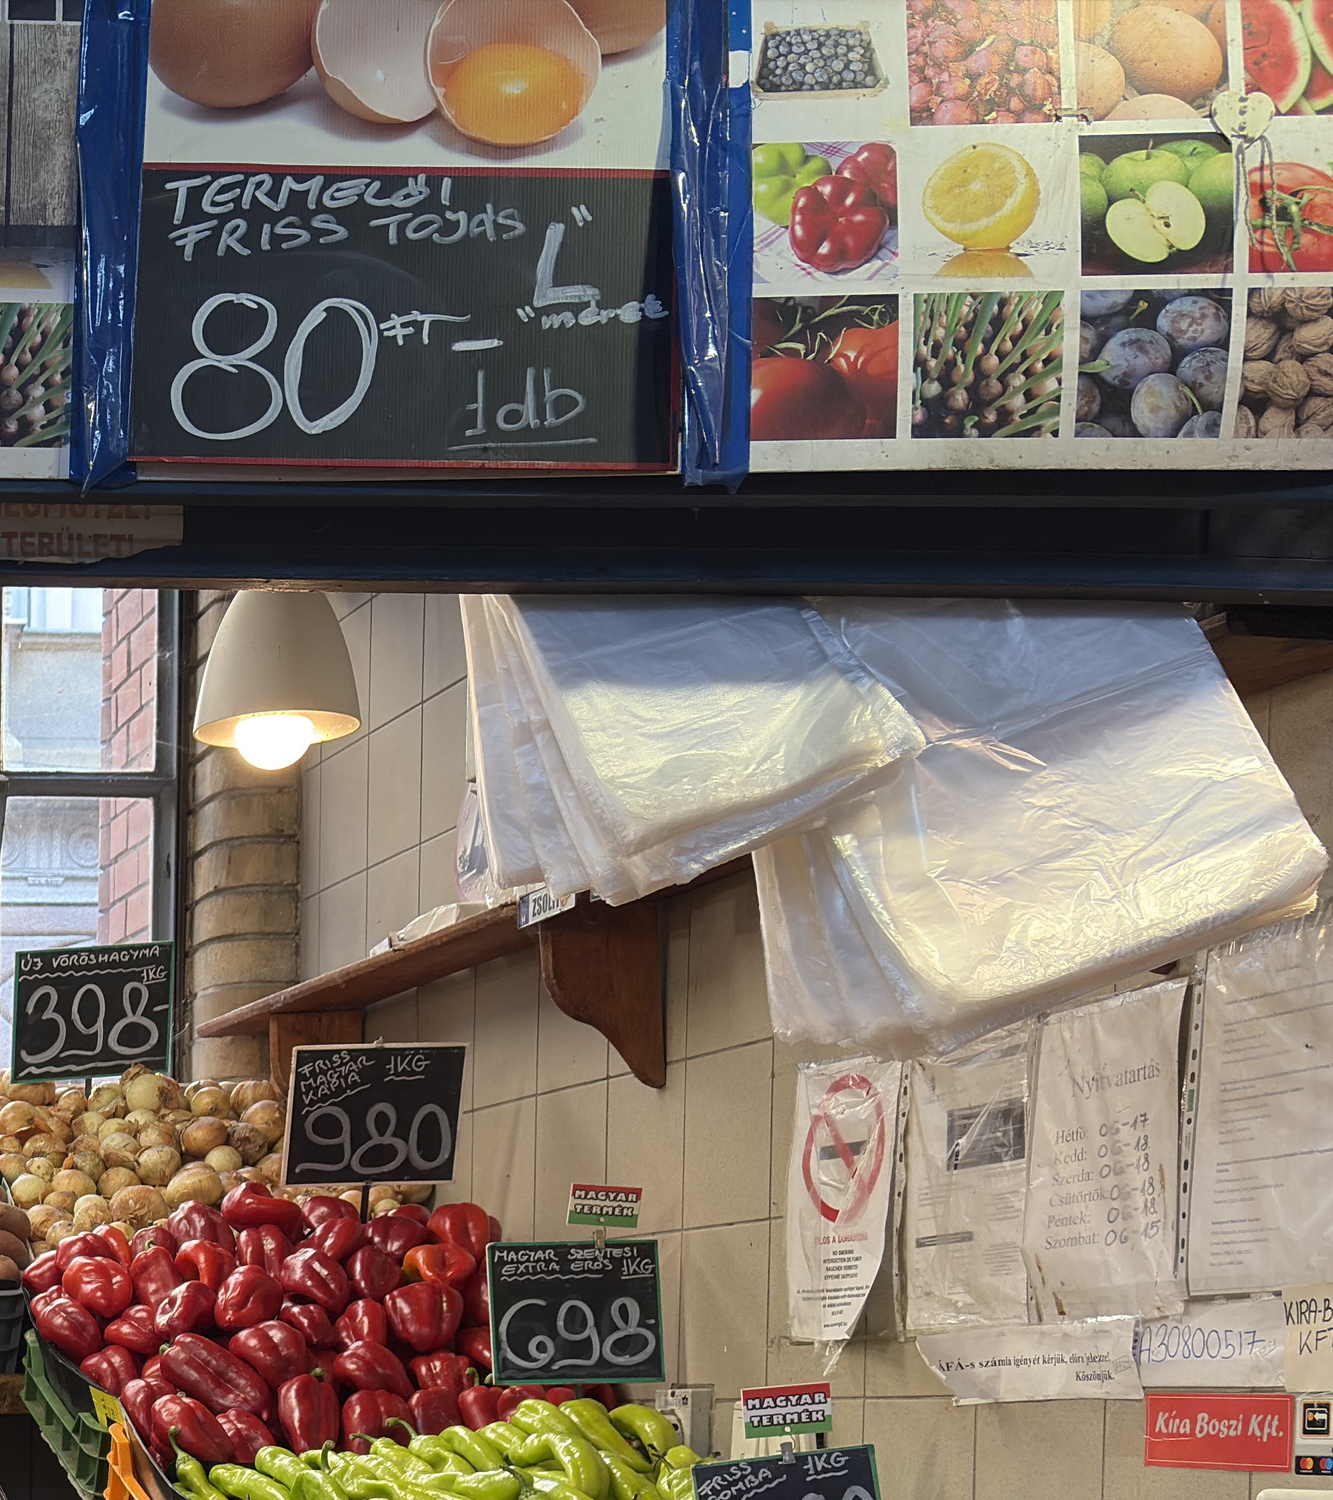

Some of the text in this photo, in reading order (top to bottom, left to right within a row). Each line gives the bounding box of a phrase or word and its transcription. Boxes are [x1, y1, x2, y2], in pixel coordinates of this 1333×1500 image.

[169, 219, 348, 261] FRISS
[171, 292, 378, 440] 80
[141, 966, 167, 982] 1KG
[298, 1051, 350, 1077] FRISS
[300, 1055, 431, 1092] MAGYAR 1KG
[295, 1102, 452, 1174] 980
[575, 1189, 638, 1202] MAGYAR
[574, 1204, 634, 1216] TERMÉK
[494, 1250, 559, 1263] MAGYAR
[501, 1258, 656, 1275] EXTRA 1KG
[979, 1356, 1011, 1368] számla
[746, 1392, 827, 1410] MAGYAR
[750, 1409, 825, 1428] TERMÉK
[1155, 1410, 1283, 1442] Kíra Boszi Kft.
[697, 1452, 849, 1496] FRISS 1KG
